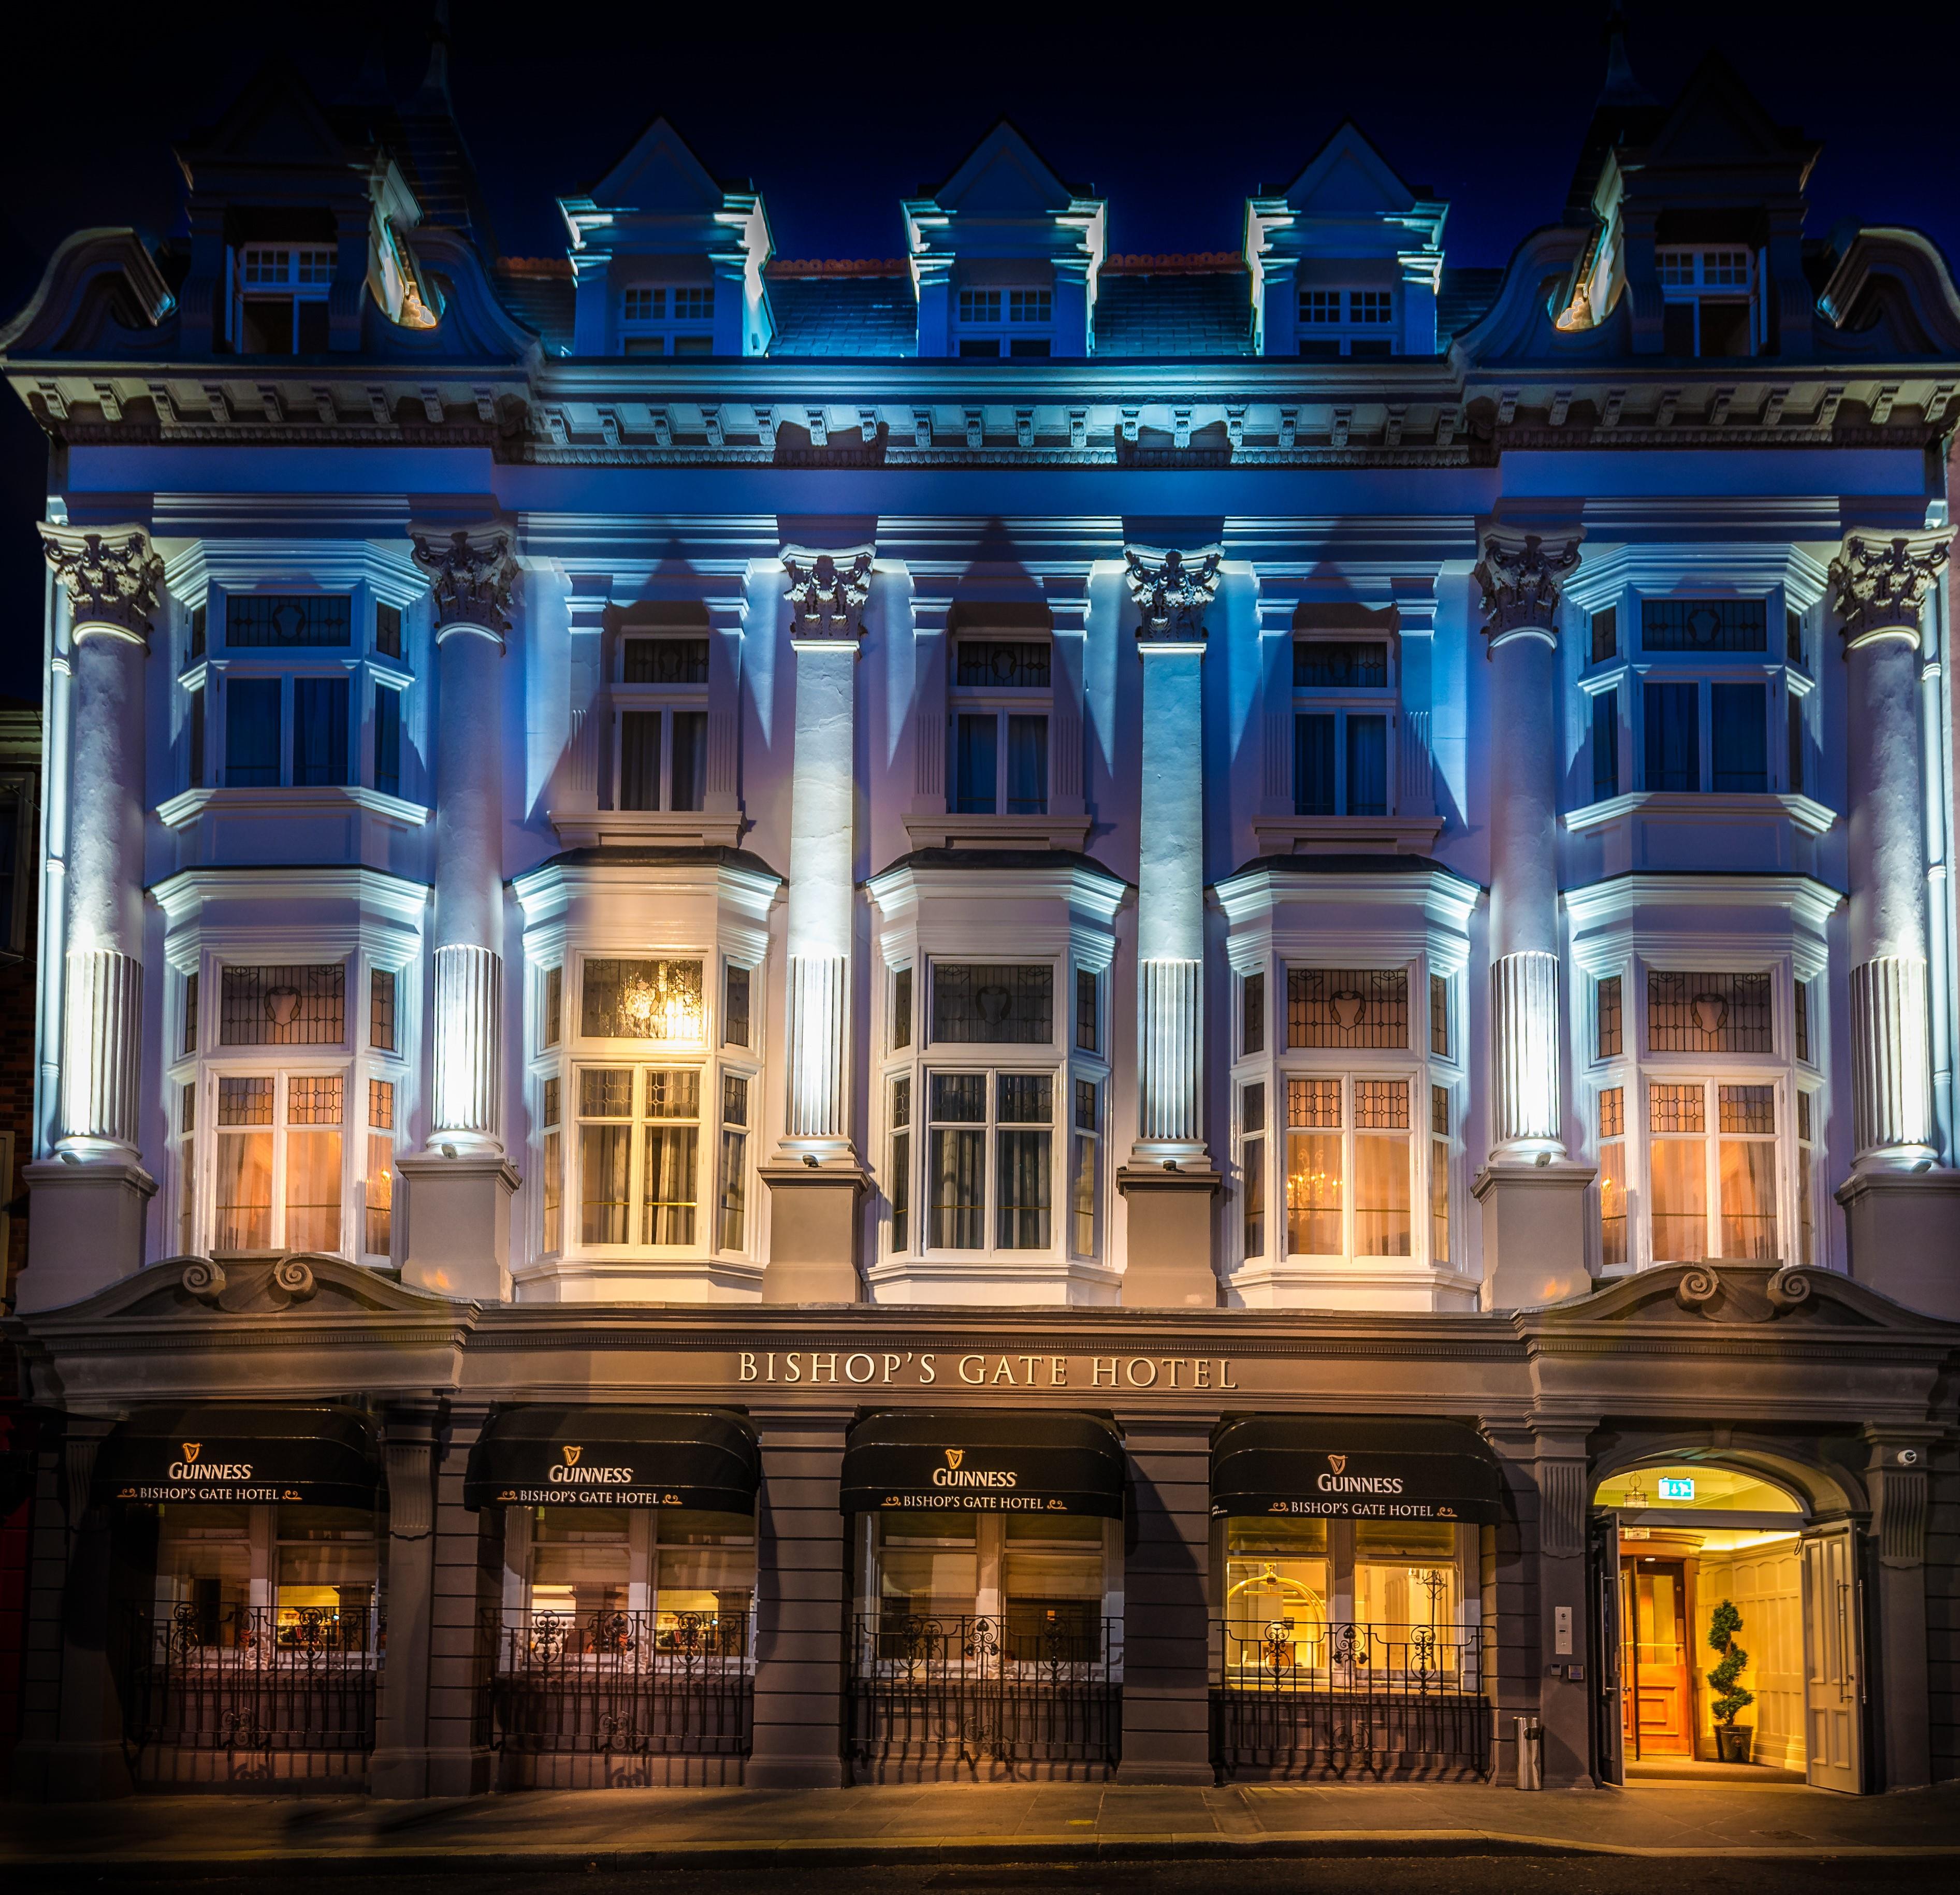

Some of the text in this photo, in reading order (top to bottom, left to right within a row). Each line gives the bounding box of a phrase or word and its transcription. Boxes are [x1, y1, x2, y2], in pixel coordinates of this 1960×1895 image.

[738, 1352, 1237, 1388] BISHOP'S GATE HOTEL
[169, 1461, 253, 1480] GUINNESS
[549, 1464, 633, 1483] GUINNESS
[933, 1468, 1017, 1487] GUINNESS
[141, 1487, 279, 1500] BISHOP'S GATE HOTEL
[1317, 1474, 1403, 1494] GUINNESS
[520, 1490, 659, 1504] BISHOP'S GATE HOTEL
[904, 1496, 1043, 1509] BISHOP'S GATE HOTEL
[1291, 1501, 1434, 1516] BISHOP'S GATE HOTEL
